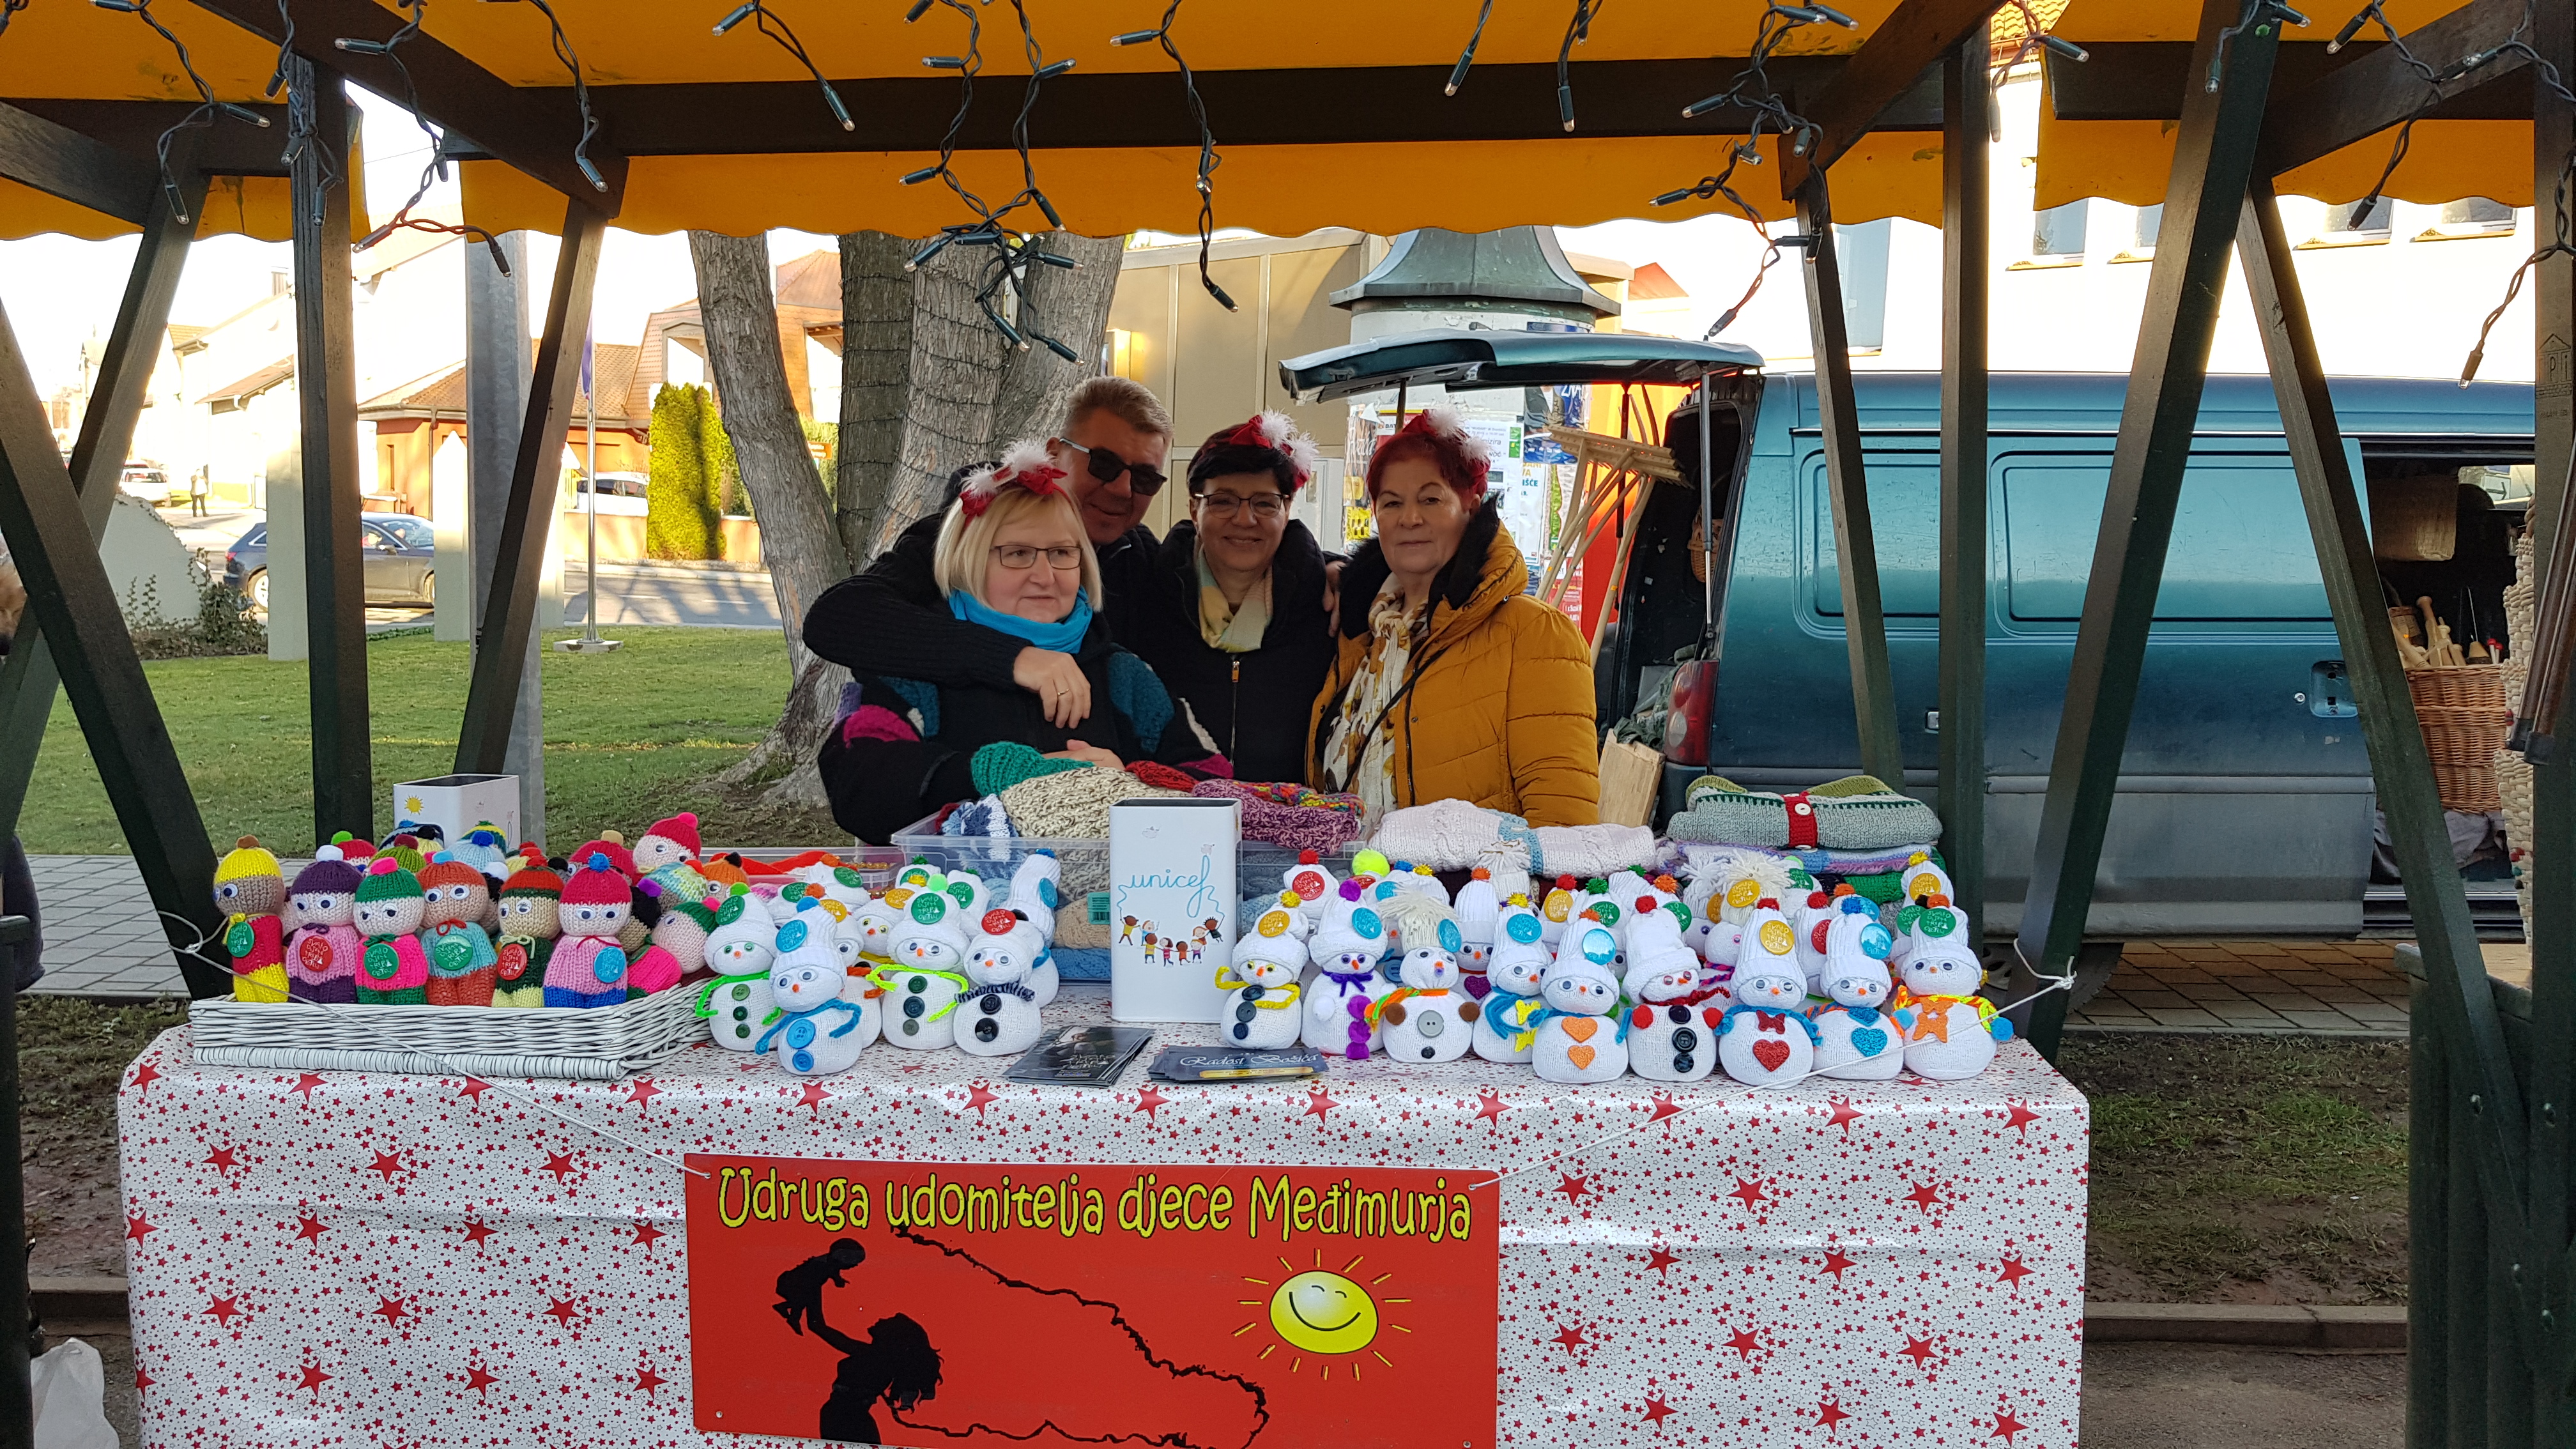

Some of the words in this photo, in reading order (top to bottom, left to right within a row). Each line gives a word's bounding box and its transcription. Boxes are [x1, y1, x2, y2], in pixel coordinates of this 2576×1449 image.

[1129, 855, 1211, 918] unicef
[718, 1166, 870, 1232] Udruga
[885, 1172, 1105, 1238] udomitelja
[1117, 1173, 1234, 1238] djece
[1248, 1174, 1471, 1243] Međimurja
